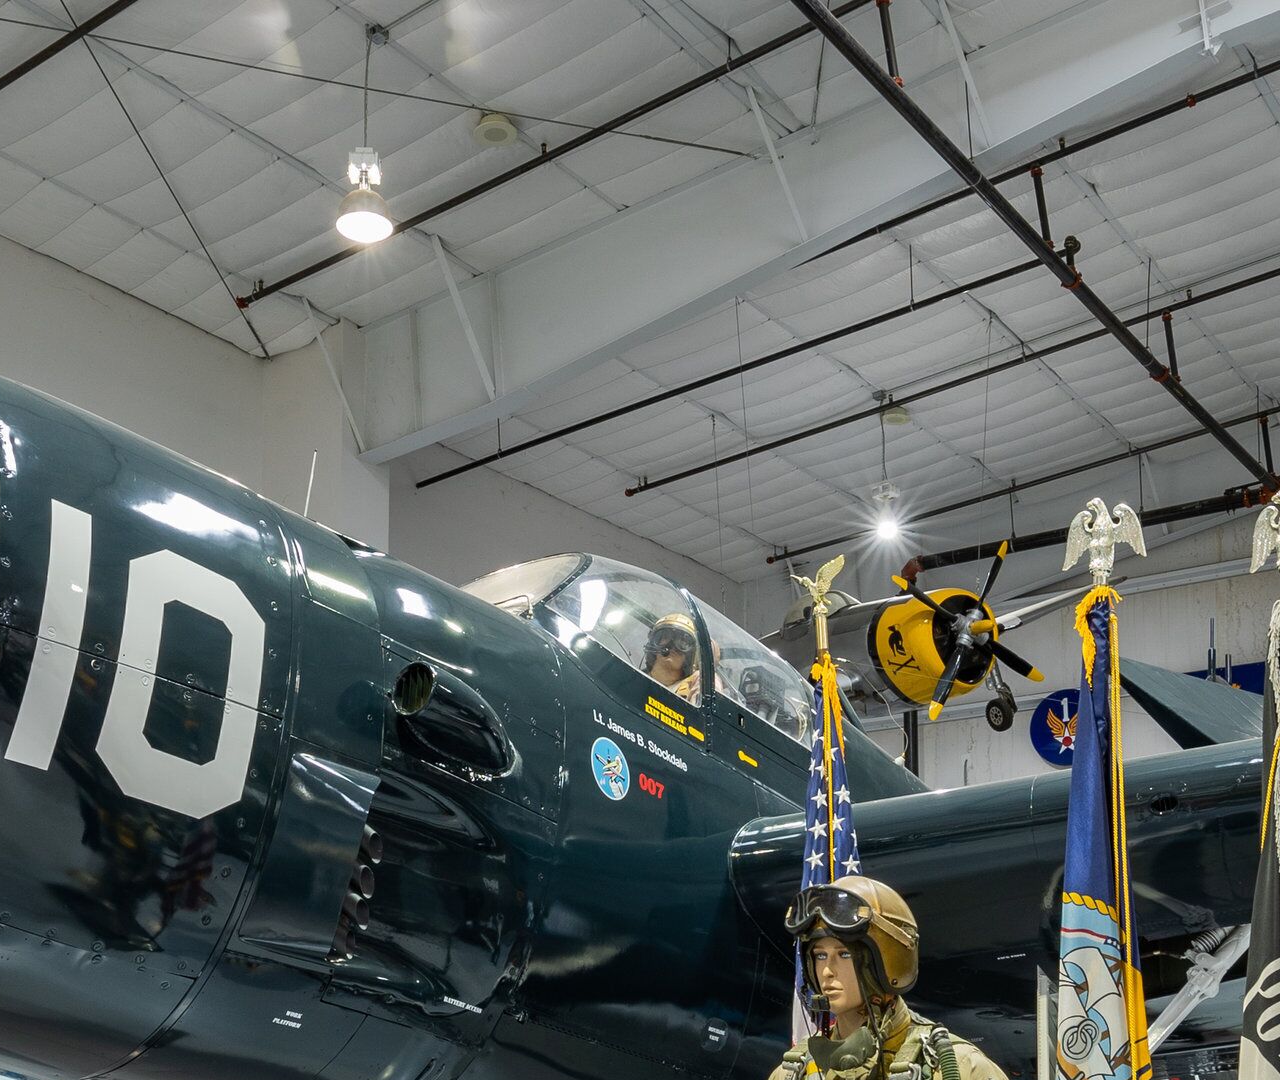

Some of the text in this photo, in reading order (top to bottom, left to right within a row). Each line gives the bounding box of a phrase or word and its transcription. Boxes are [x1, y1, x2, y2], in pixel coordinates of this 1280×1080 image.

[4, 499, 266, 819] 10
[645, 703, 688, 736] EXIT RELEASE
[648, 696, 685, 724] EMERGENCY
[1060, 697, 1070, 721] 1
[593, 708, 688, 772] Lt. James B. Stockdale
[639, 772, 665, 799] 007
[272, 1017, 302, 1029] PLATFORM
